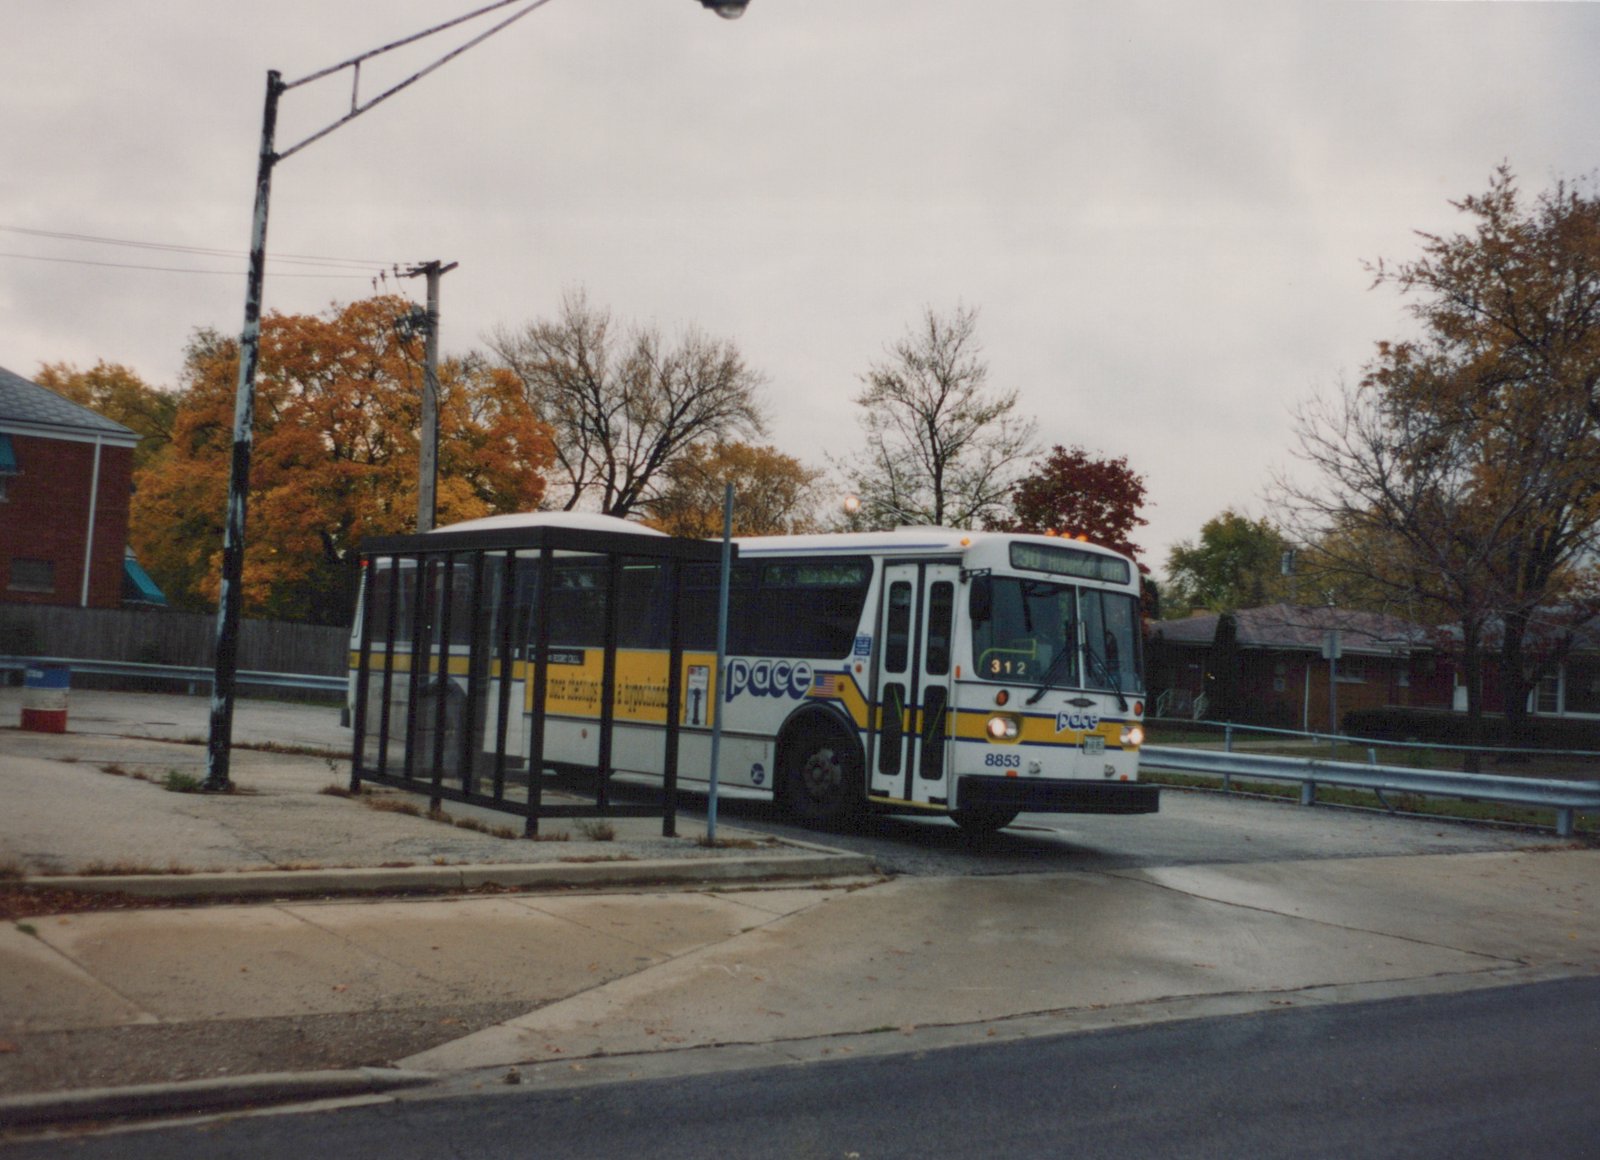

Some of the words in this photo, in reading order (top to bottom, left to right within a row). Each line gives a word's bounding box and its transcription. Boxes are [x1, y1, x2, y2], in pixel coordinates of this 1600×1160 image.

[990, 659, 1027, 675] 312
[725, 658, 813, 703] pace
[1056, 711, 1099, 733] pace
[985, 753, 1021, 768] 8853
